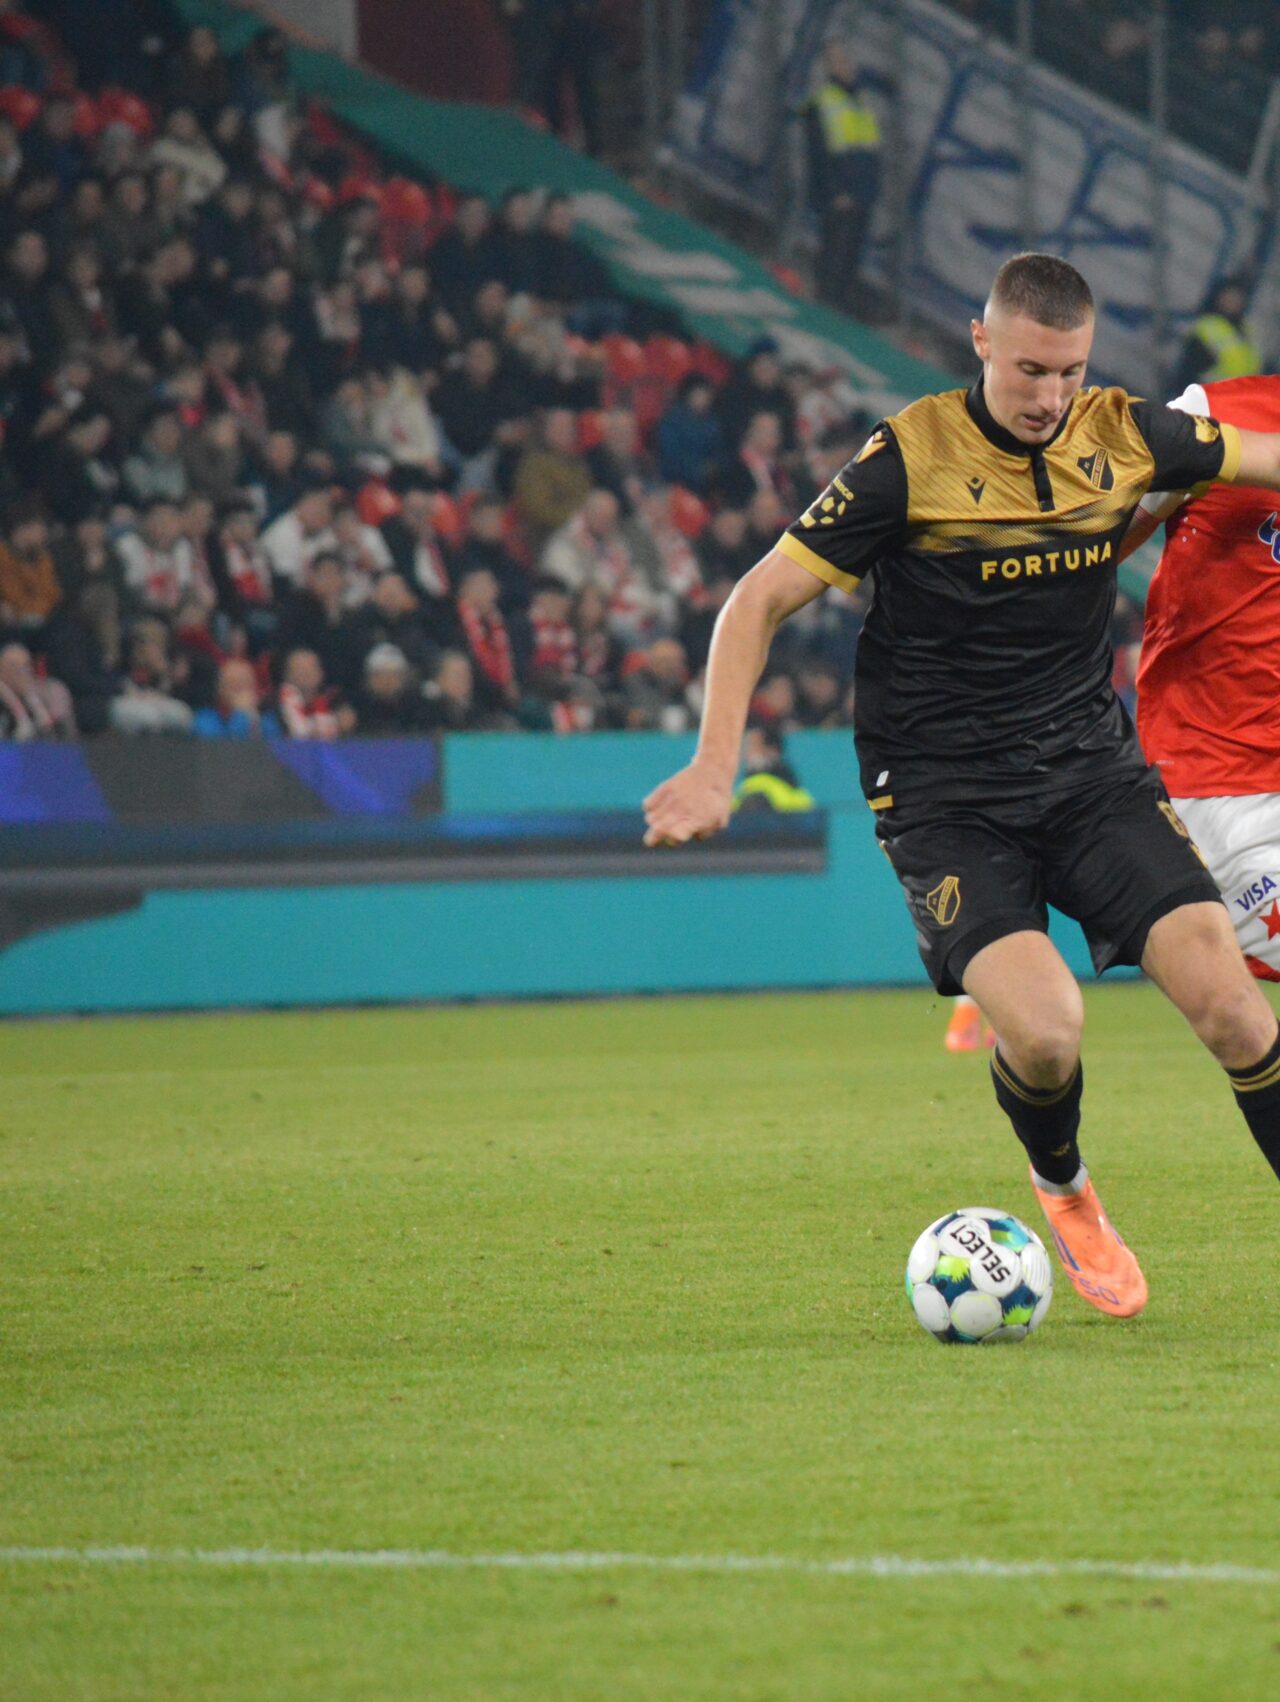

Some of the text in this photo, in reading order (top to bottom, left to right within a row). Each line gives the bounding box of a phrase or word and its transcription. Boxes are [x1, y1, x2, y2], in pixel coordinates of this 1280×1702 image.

[981, 540, 1112, 581] FORTUNA
[1235, 874, 1277, 912] VISA
[950, 1224, 1011, 1283] SELECT
